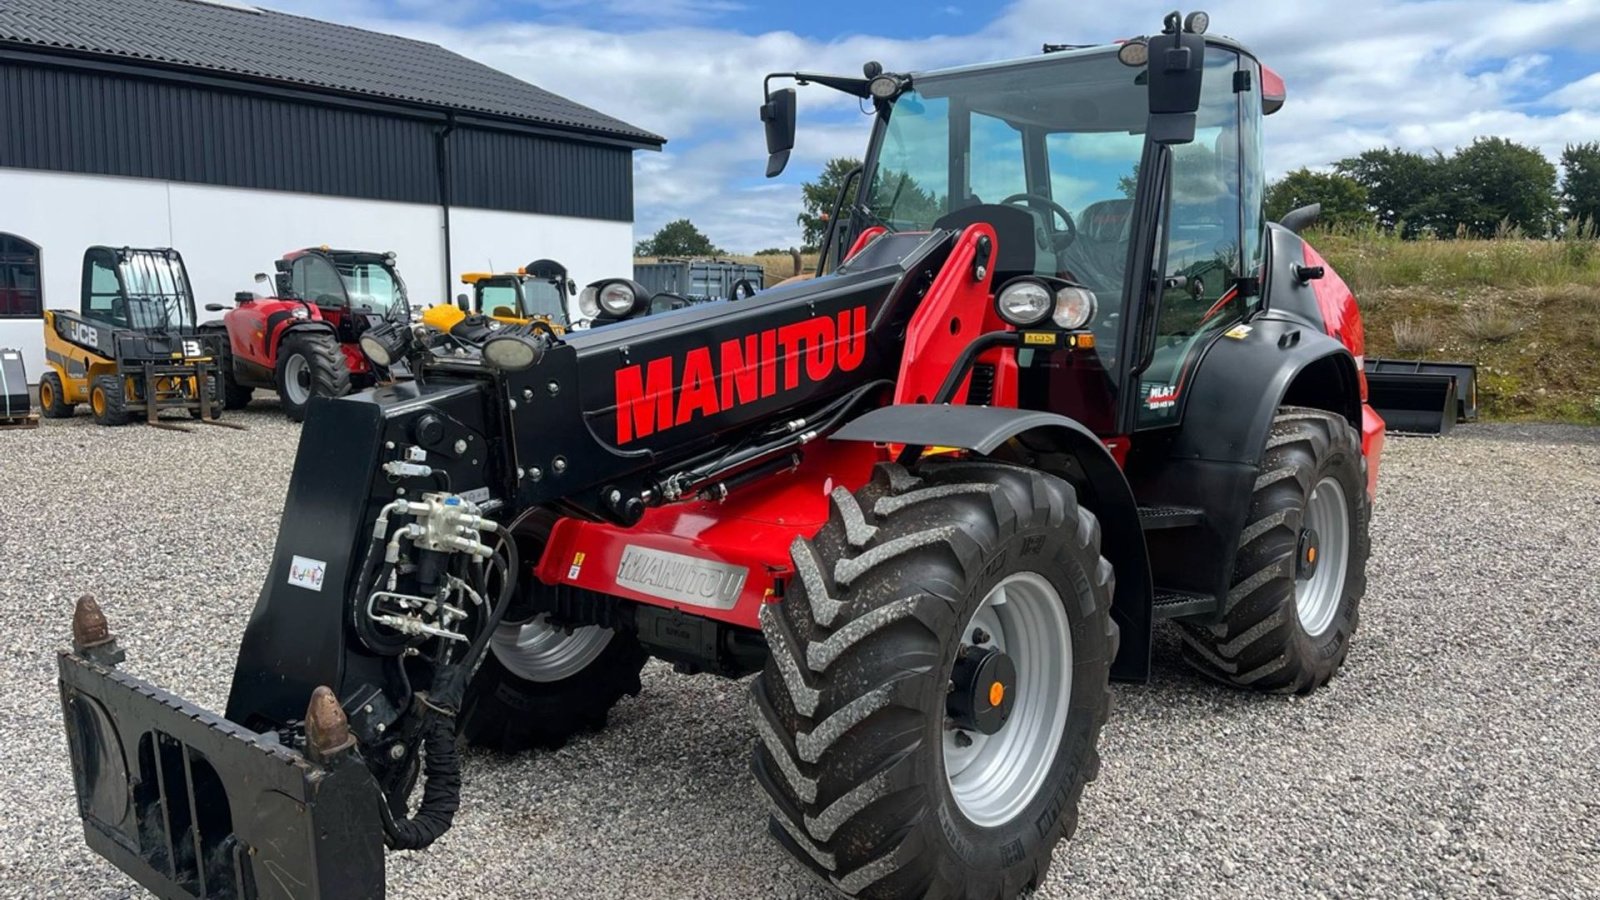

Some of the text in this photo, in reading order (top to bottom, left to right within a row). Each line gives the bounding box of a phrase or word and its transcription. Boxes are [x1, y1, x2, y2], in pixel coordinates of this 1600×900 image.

[71, 321, 99, 347] JCB
[615, 305, 867, 445] MANITOU
[617, 551, 744, 602] MANITOU
